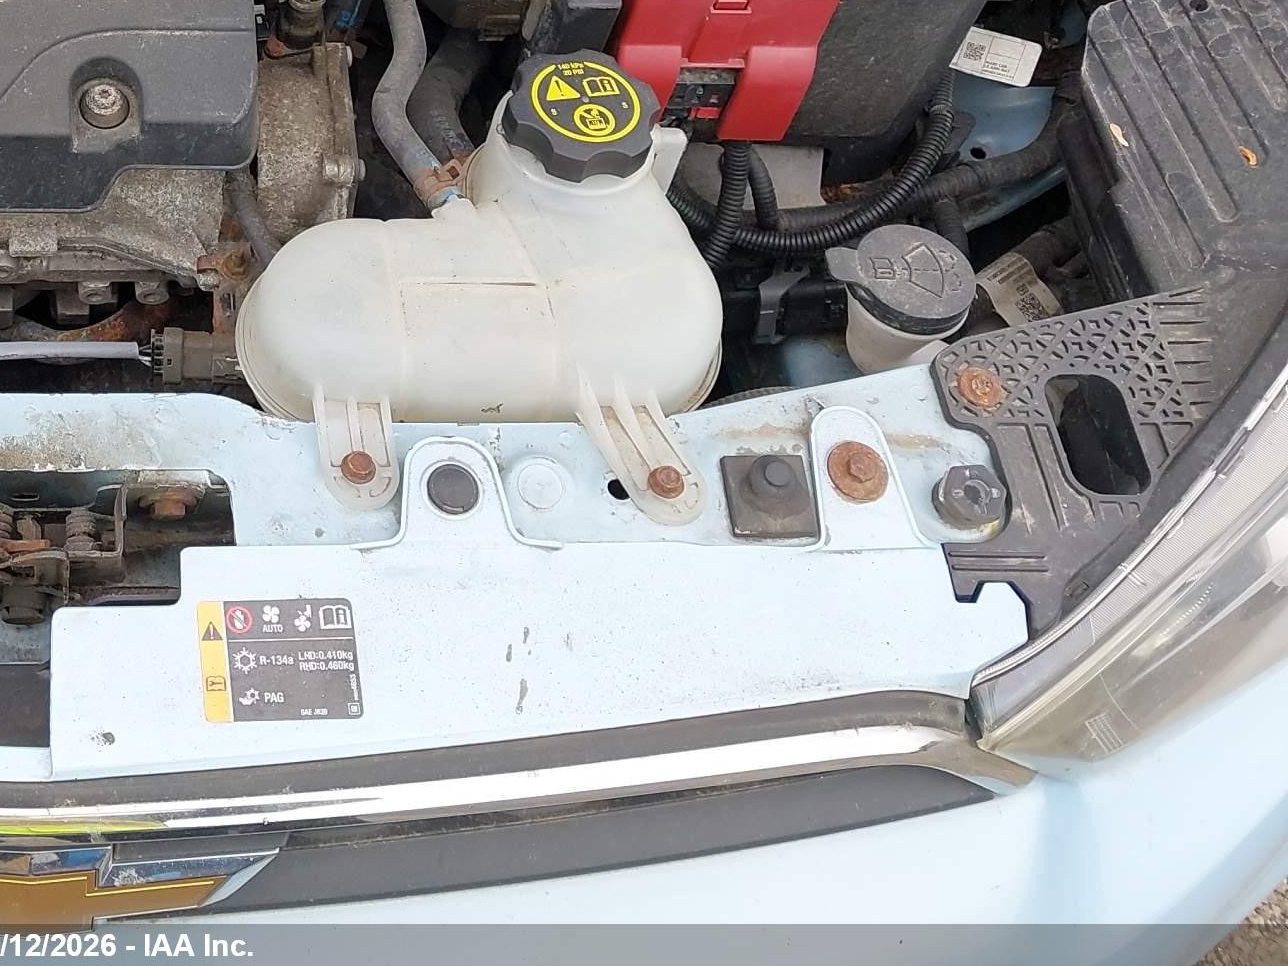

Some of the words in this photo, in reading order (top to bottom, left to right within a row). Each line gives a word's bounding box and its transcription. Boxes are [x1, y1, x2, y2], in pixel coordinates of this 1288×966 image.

[262, 624, 284, 633] AUTO
[259, 655, 294, 665] R-134a
[264, 692, 284, 703] PAG
